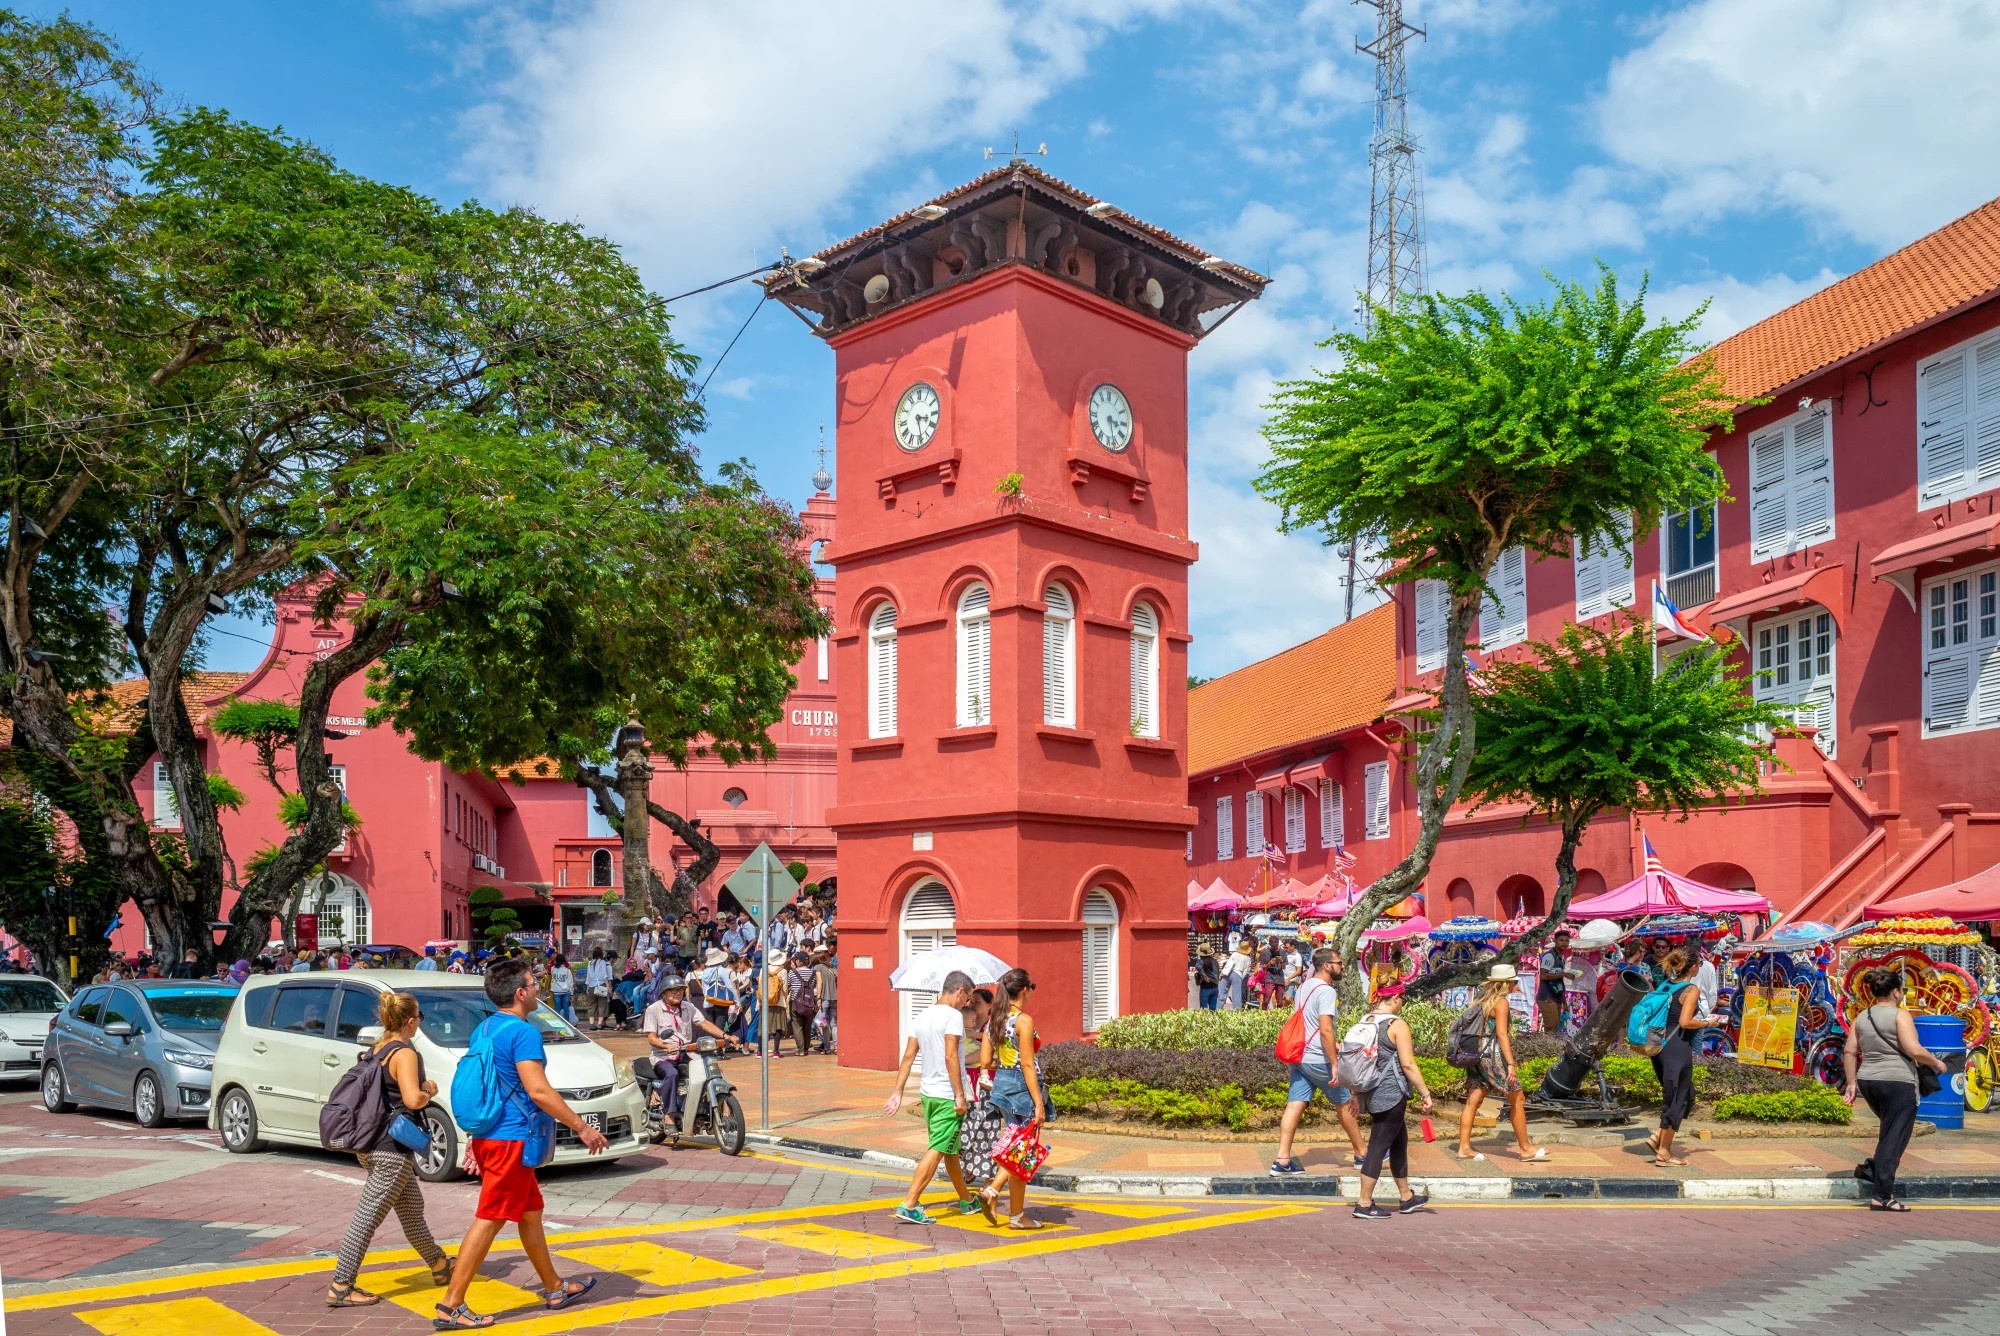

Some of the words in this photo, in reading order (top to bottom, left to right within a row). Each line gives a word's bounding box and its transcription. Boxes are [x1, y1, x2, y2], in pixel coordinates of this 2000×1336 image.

[317, 639, 336, 649] AD
[791, 709, 838, 726] CHUR
[581, 1113, 599, 1124] WTS
